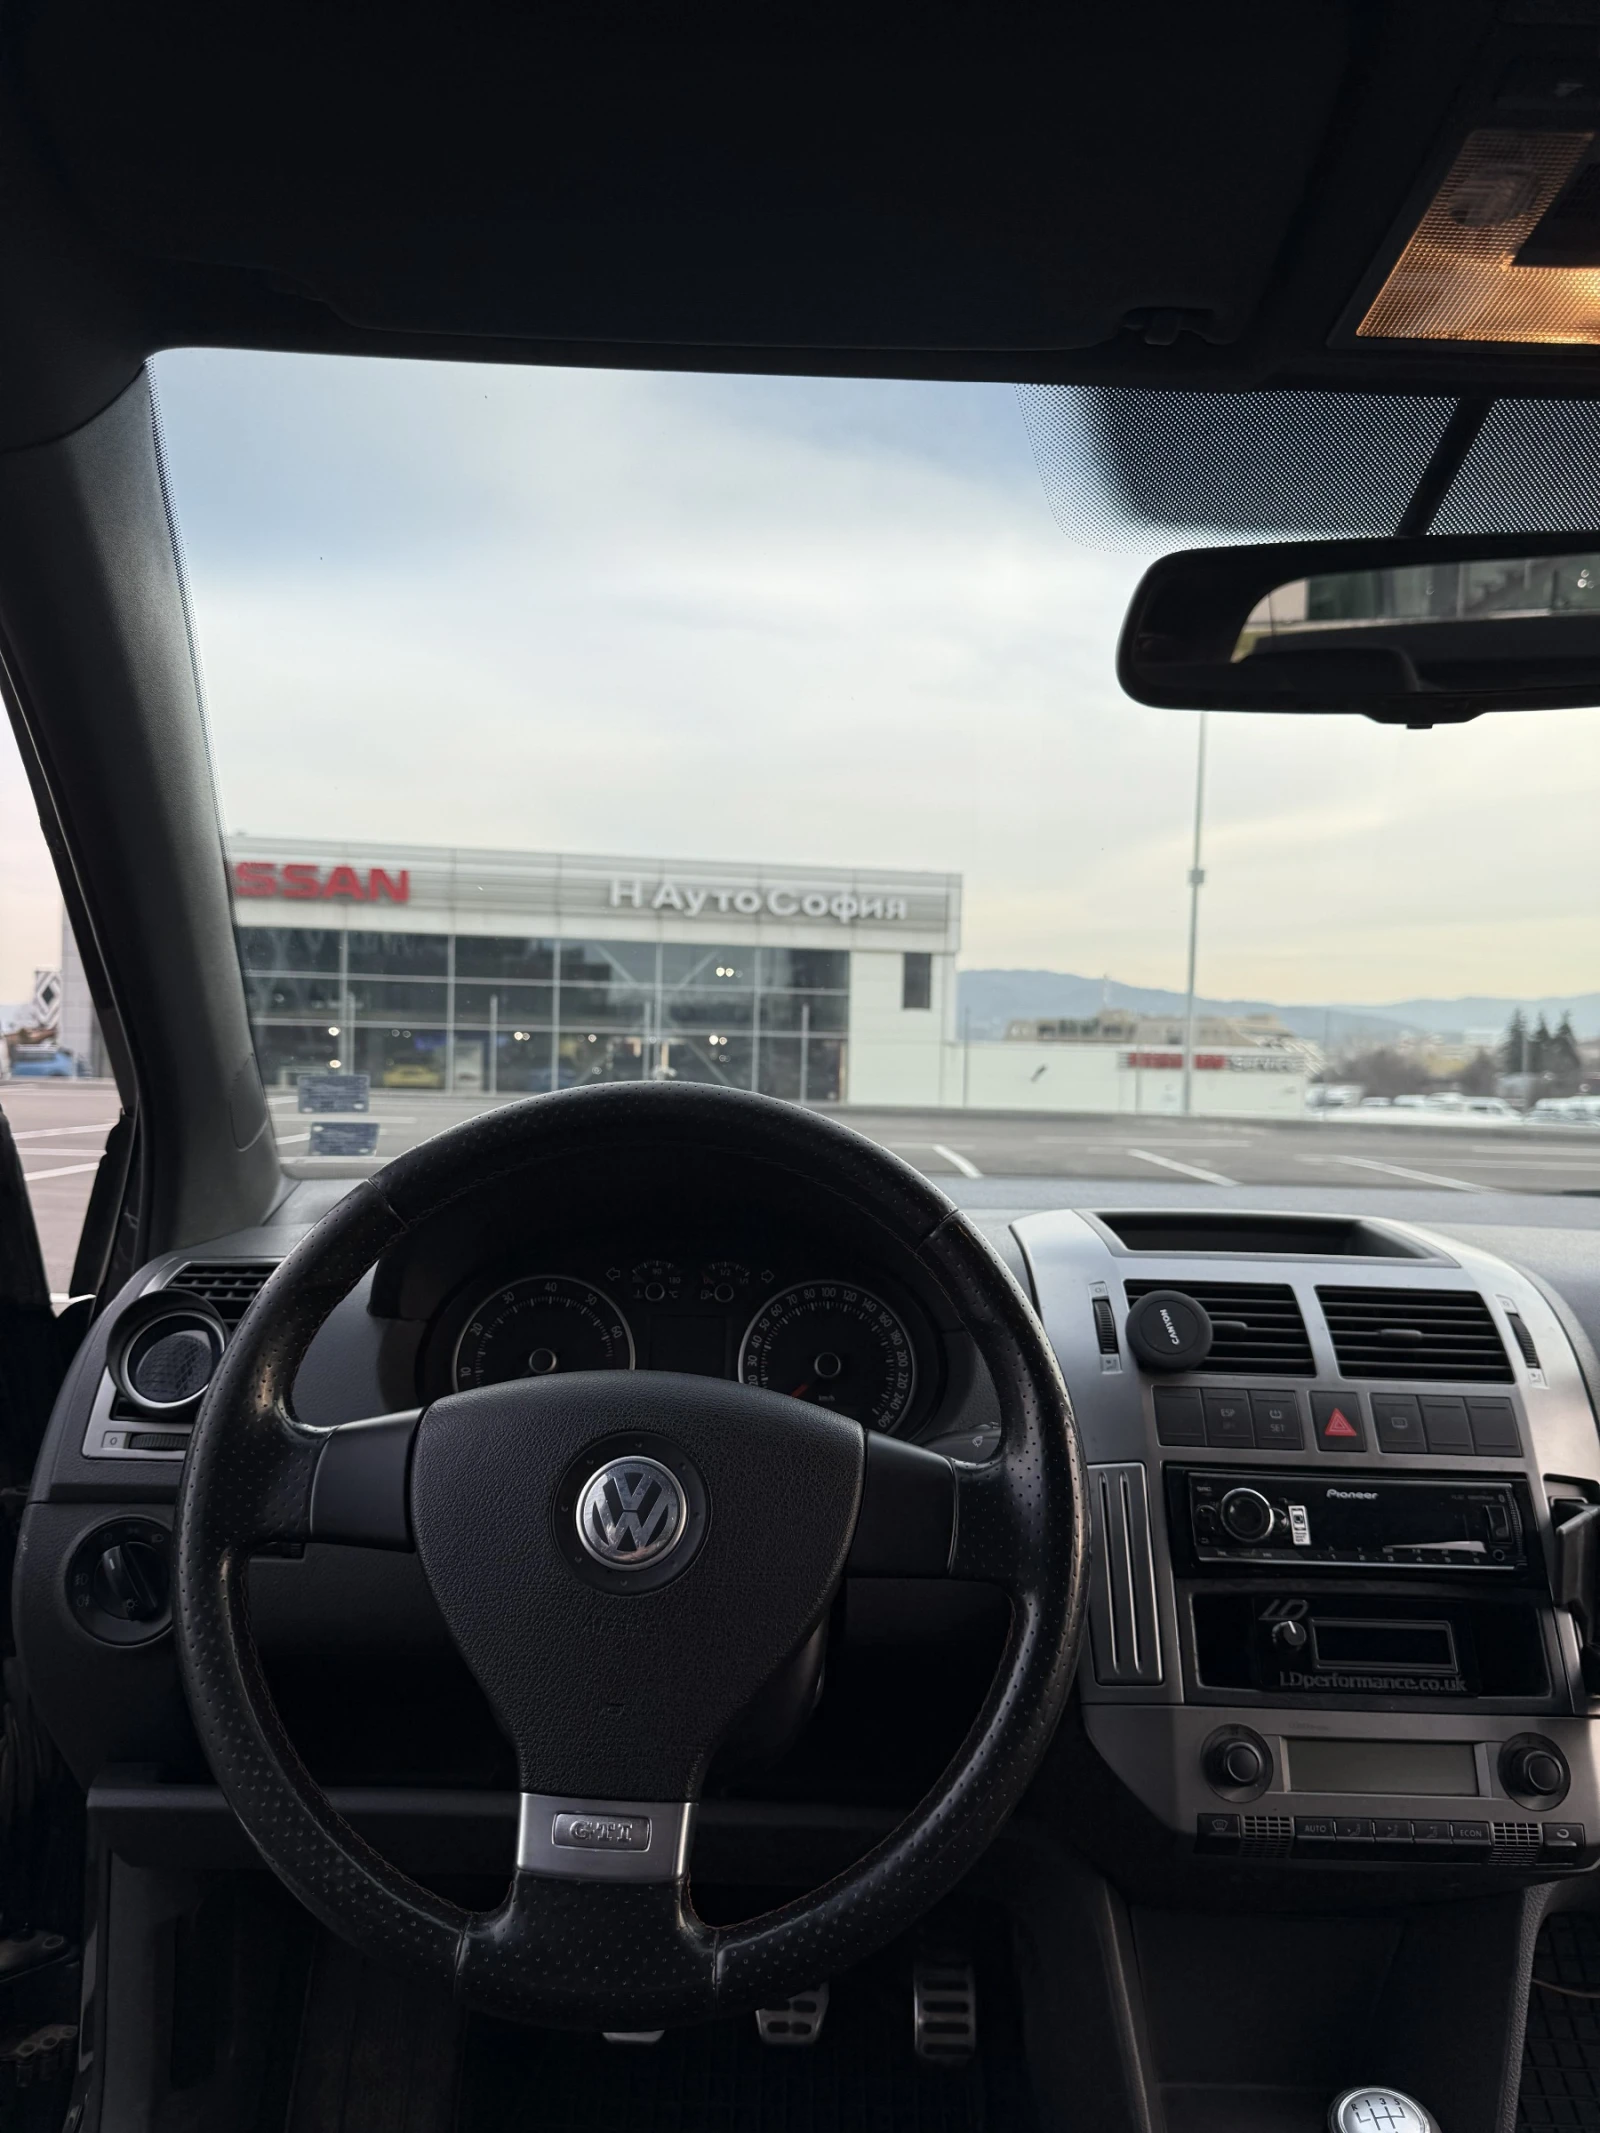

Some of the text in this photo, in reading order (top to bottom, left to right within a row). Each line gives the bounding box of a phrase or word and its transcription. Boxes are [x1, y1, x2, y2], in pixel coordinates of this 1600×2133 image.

[544, 1282, 557, 1292] 40
[803, 1288, 816, 1299] 80
[821, 1287, 836, 1298] 100
[501, 1291, 515, 1304] 30
[584, 1293, 598, 1306] 50
[786, 1294, 798, 1306] 70
[843, 1290, 857, 1302] 120
[770, 1303, 783, 1317] 60
[862, 1297, 877, 1313] 140
[759, 1318, 770, 1331] 50
[878, 1311, 893, 1327] 160
[470, 1322, 483, 1336] 20
[610, 1325, 623, 1338] 60
[1159, 1308, 1180, 1345] CANYON
[751, 1335, 762, 1348] 40
[889, 1329, 903, 1346] 180
[747, 1354, 758, 1367] 30
[896, 1349, 909, 1367] 200
[460, 1366, 472, 1378] 10
[896, 1371, 909, 1389] 220
[890, 1392, 905, 1410] 240
[878, 1410, 895, 1428] 260
[1269, 1423, 1285, 1432] SET
[1326, 1488, 1379, 1500] Pioneer
[1279, 1671, 1468, 1692] LDperformance.co.uk
[569, 1820, 633, 1842] GTI
[1304, 1825, 1326, 1834] AUTO
[1459, 1828, 1482, 1838] ECON
[1351, 2103, 1358, 2111] R
[1379, 2097, 1386, 2105] 3
